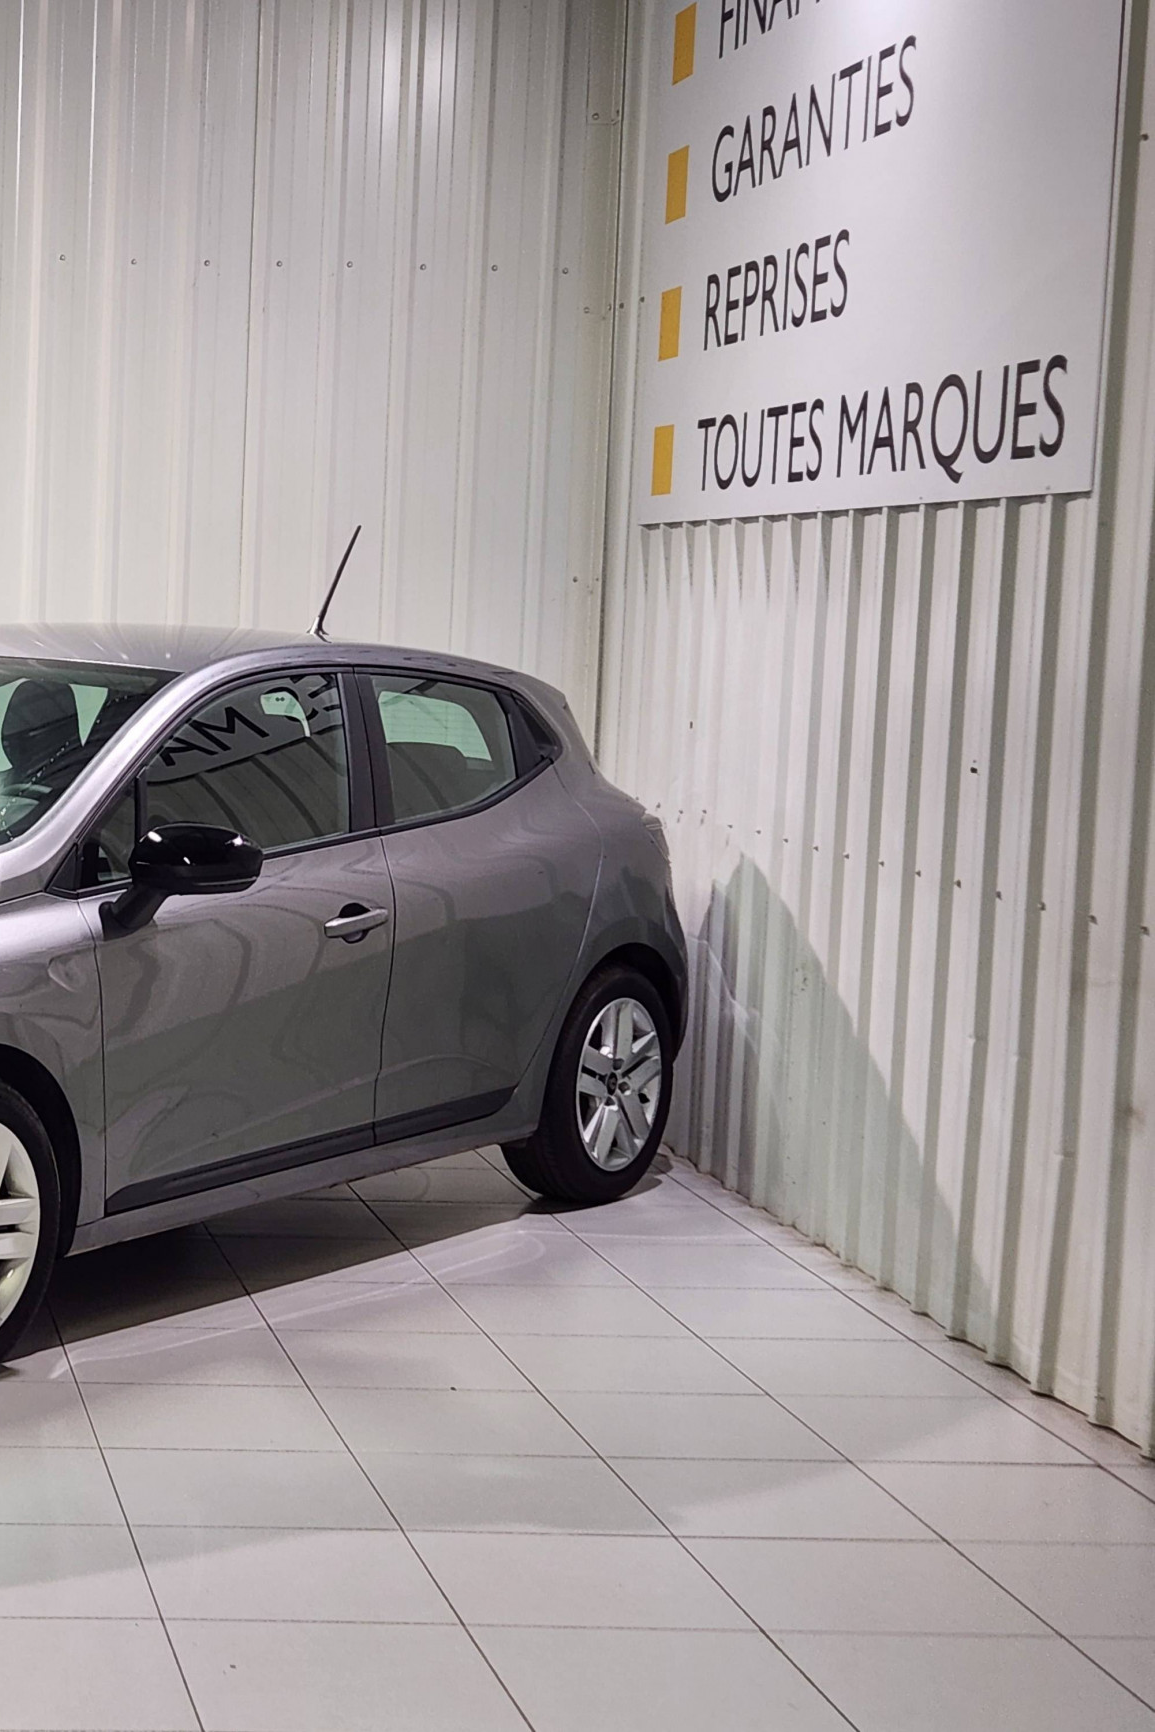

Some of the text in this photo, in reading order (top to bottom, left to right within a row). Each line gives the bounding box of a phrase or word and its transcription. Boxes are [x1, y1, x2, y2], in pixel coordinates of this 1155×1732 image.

[712, 35, 917, 203] GARANTIES
[703, 229, 850, 351] REPRISES
[697, 354, 1068, 492] TOUTES MARQUES
